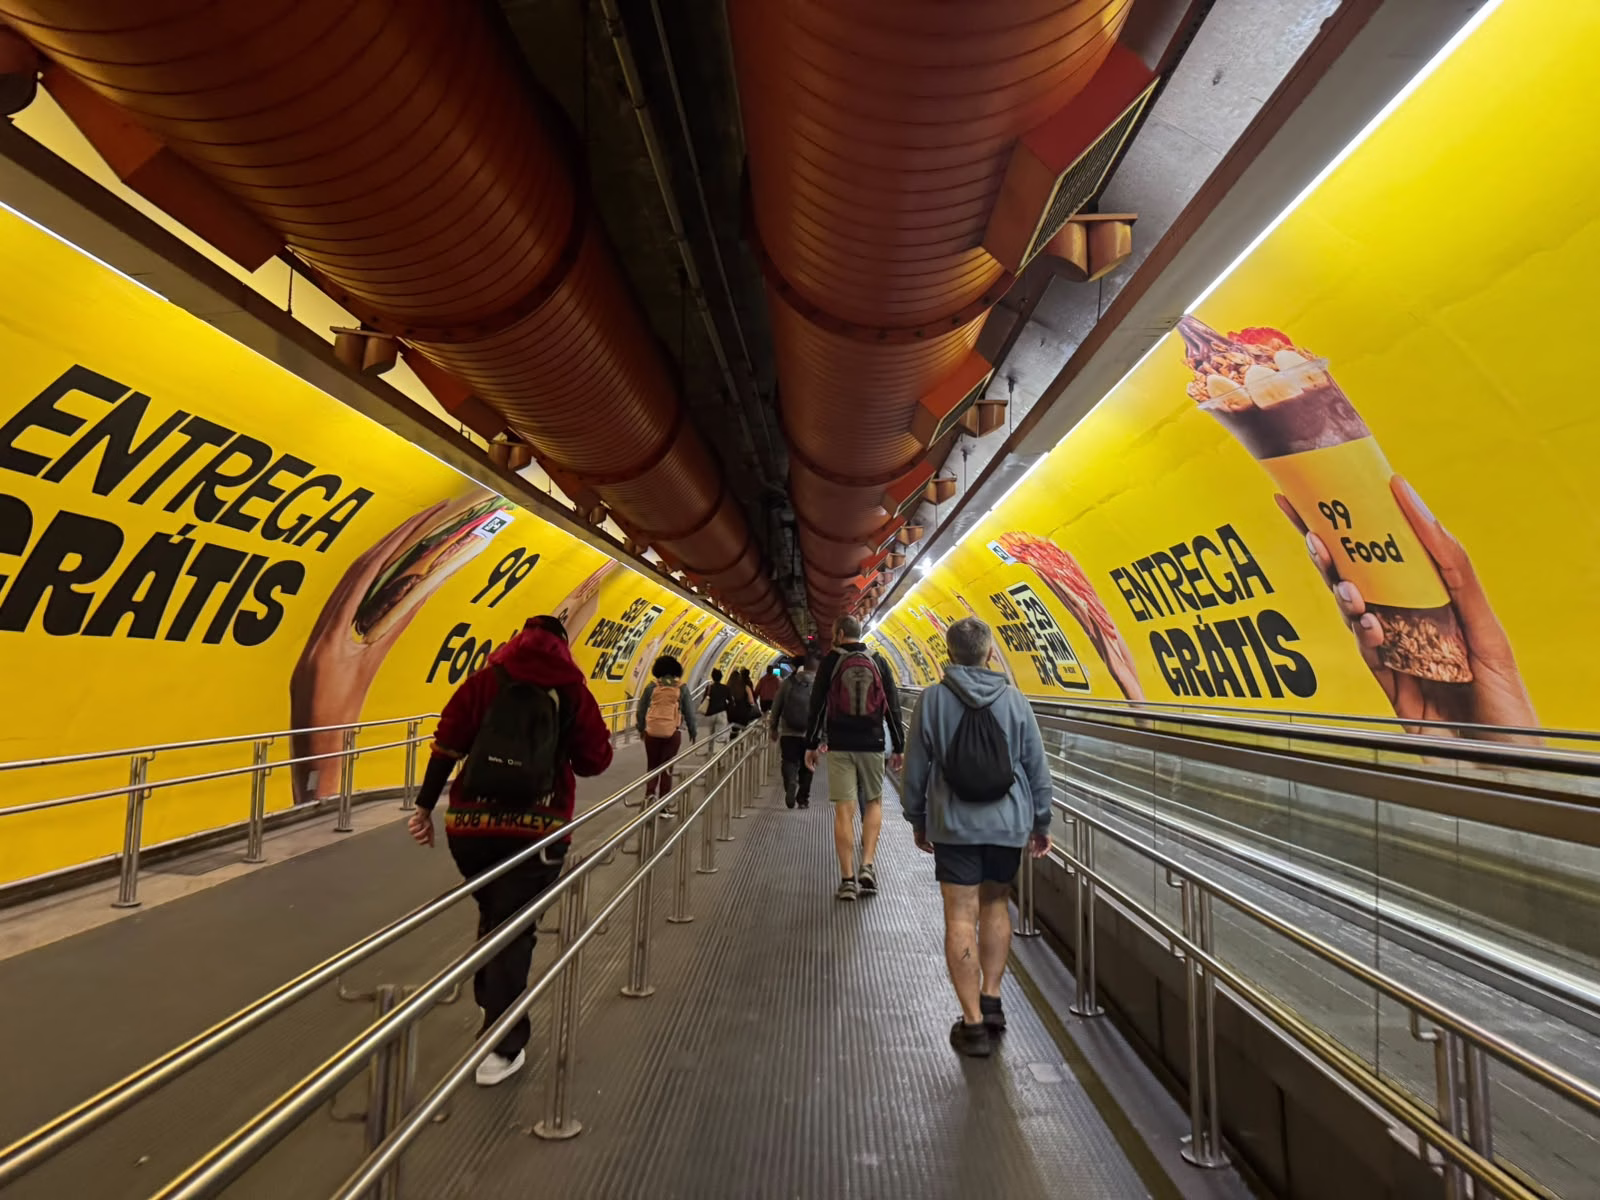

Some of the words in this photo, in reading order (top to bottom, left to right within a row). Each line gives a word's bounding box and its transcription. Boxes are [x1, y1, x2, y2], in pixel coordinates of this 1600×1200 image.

[0, 364, 375, 553] ENTREGA
[1318, 500, 1352, 530] 99
[1340, 533, 1404, 563] Food
[470, 547, 540, 608] 99
[1109, 523, 1275, 622] ENTREGA
[620, 597, 651, 623] SEU
[989, 592, 1020, 621] SEU
[1022, 596, 1053, 630] 29
[996, 622, 1039, 652] PEDIDO
[1043, 631, 1074, 661] MIN
[426, 622, 518, 685] Foo
[1149, 609, 1318, 698] GRÁTIS
[455, 813, 481, 828] BOB
[487, 814, 554, 831] MARLEY
